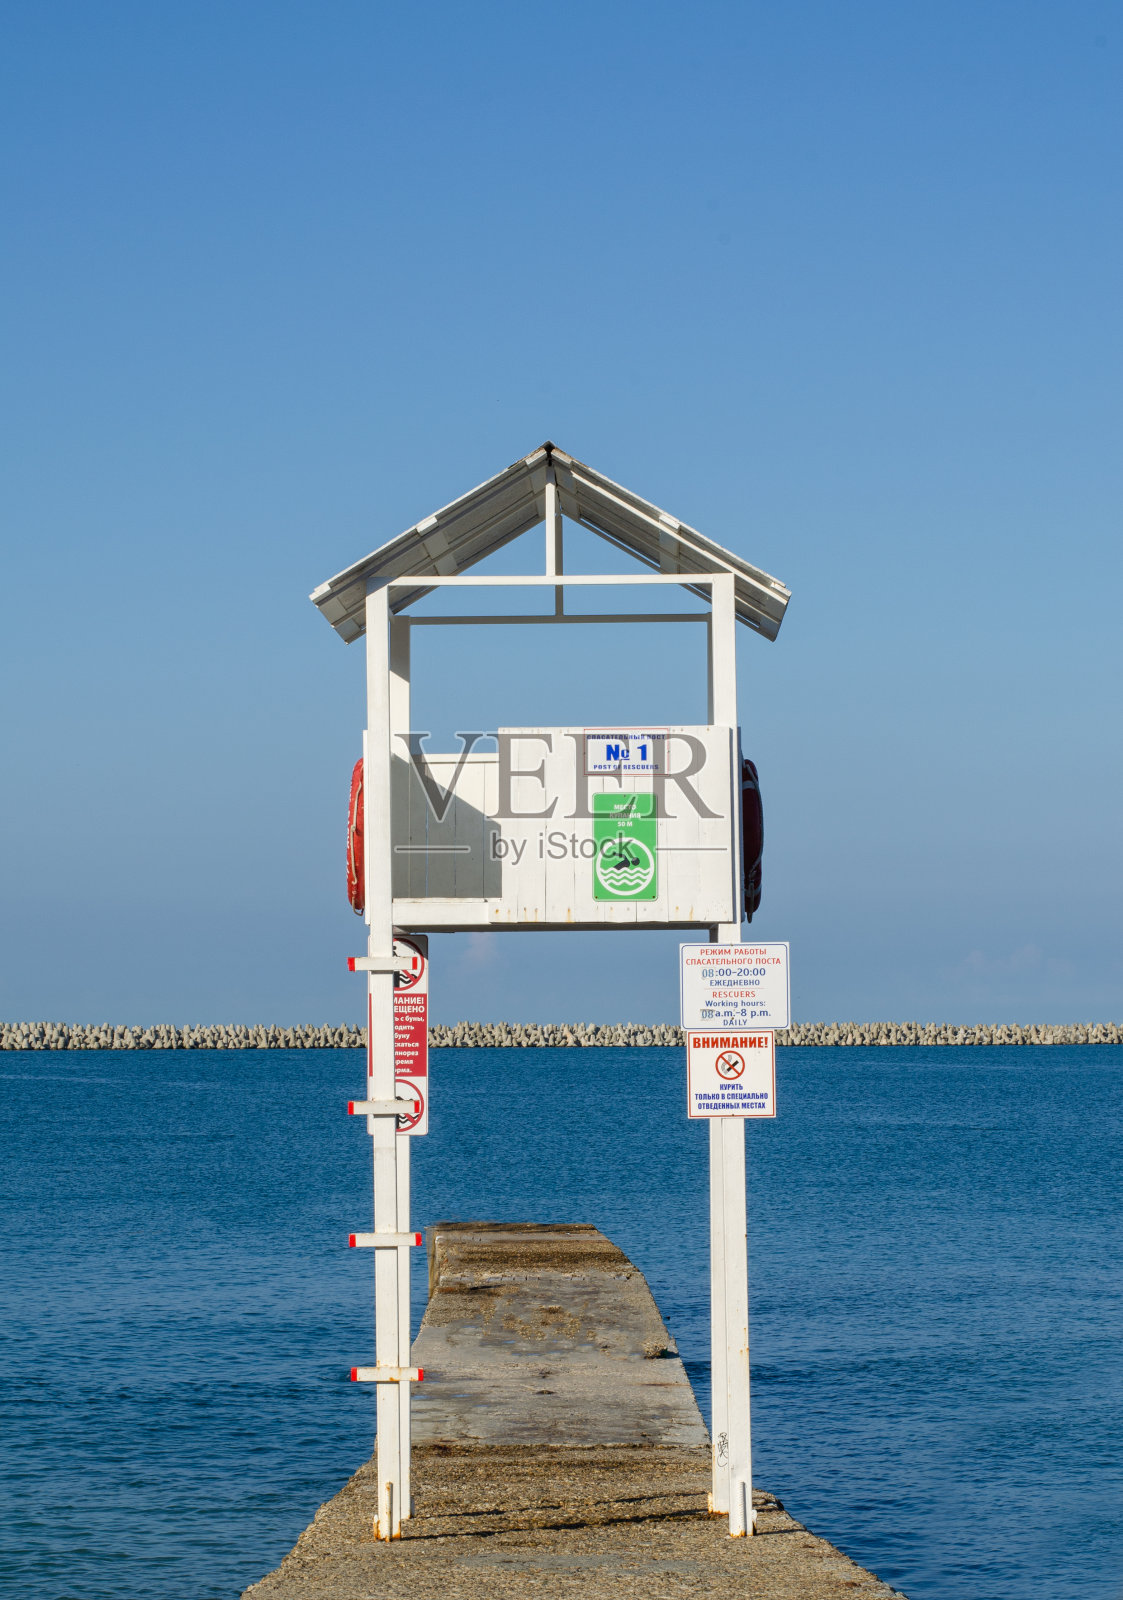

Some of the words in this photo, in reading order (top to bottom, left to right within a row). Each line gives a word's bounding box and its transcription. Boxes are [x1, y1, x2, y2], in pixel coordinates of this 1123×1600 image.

[637, 744, 647, 761] 1
[700, 948, 731, 956] РЕЖИМ
[686, 958, 753, 966] СПАСАТЕЛЬНОГО
[755, 957, 781, 965] ПОСТА
[709, 979, 760, 987] ЕЖЕДНЕВНО
[712, 990, 756, 998] RESCUERS
[705, 1000, 738, 1008] Working
[741, 999, 766, 1007] hours:
[750, 1009, 771, 1018] p.m.
[693, 1036, 768, 1049] ВНИМАНИЕ!
[719, 1083, 743, 1091] КУРИТЬ
[697, 1102, 740, 1110] ОТВЕДЕННЫХ
